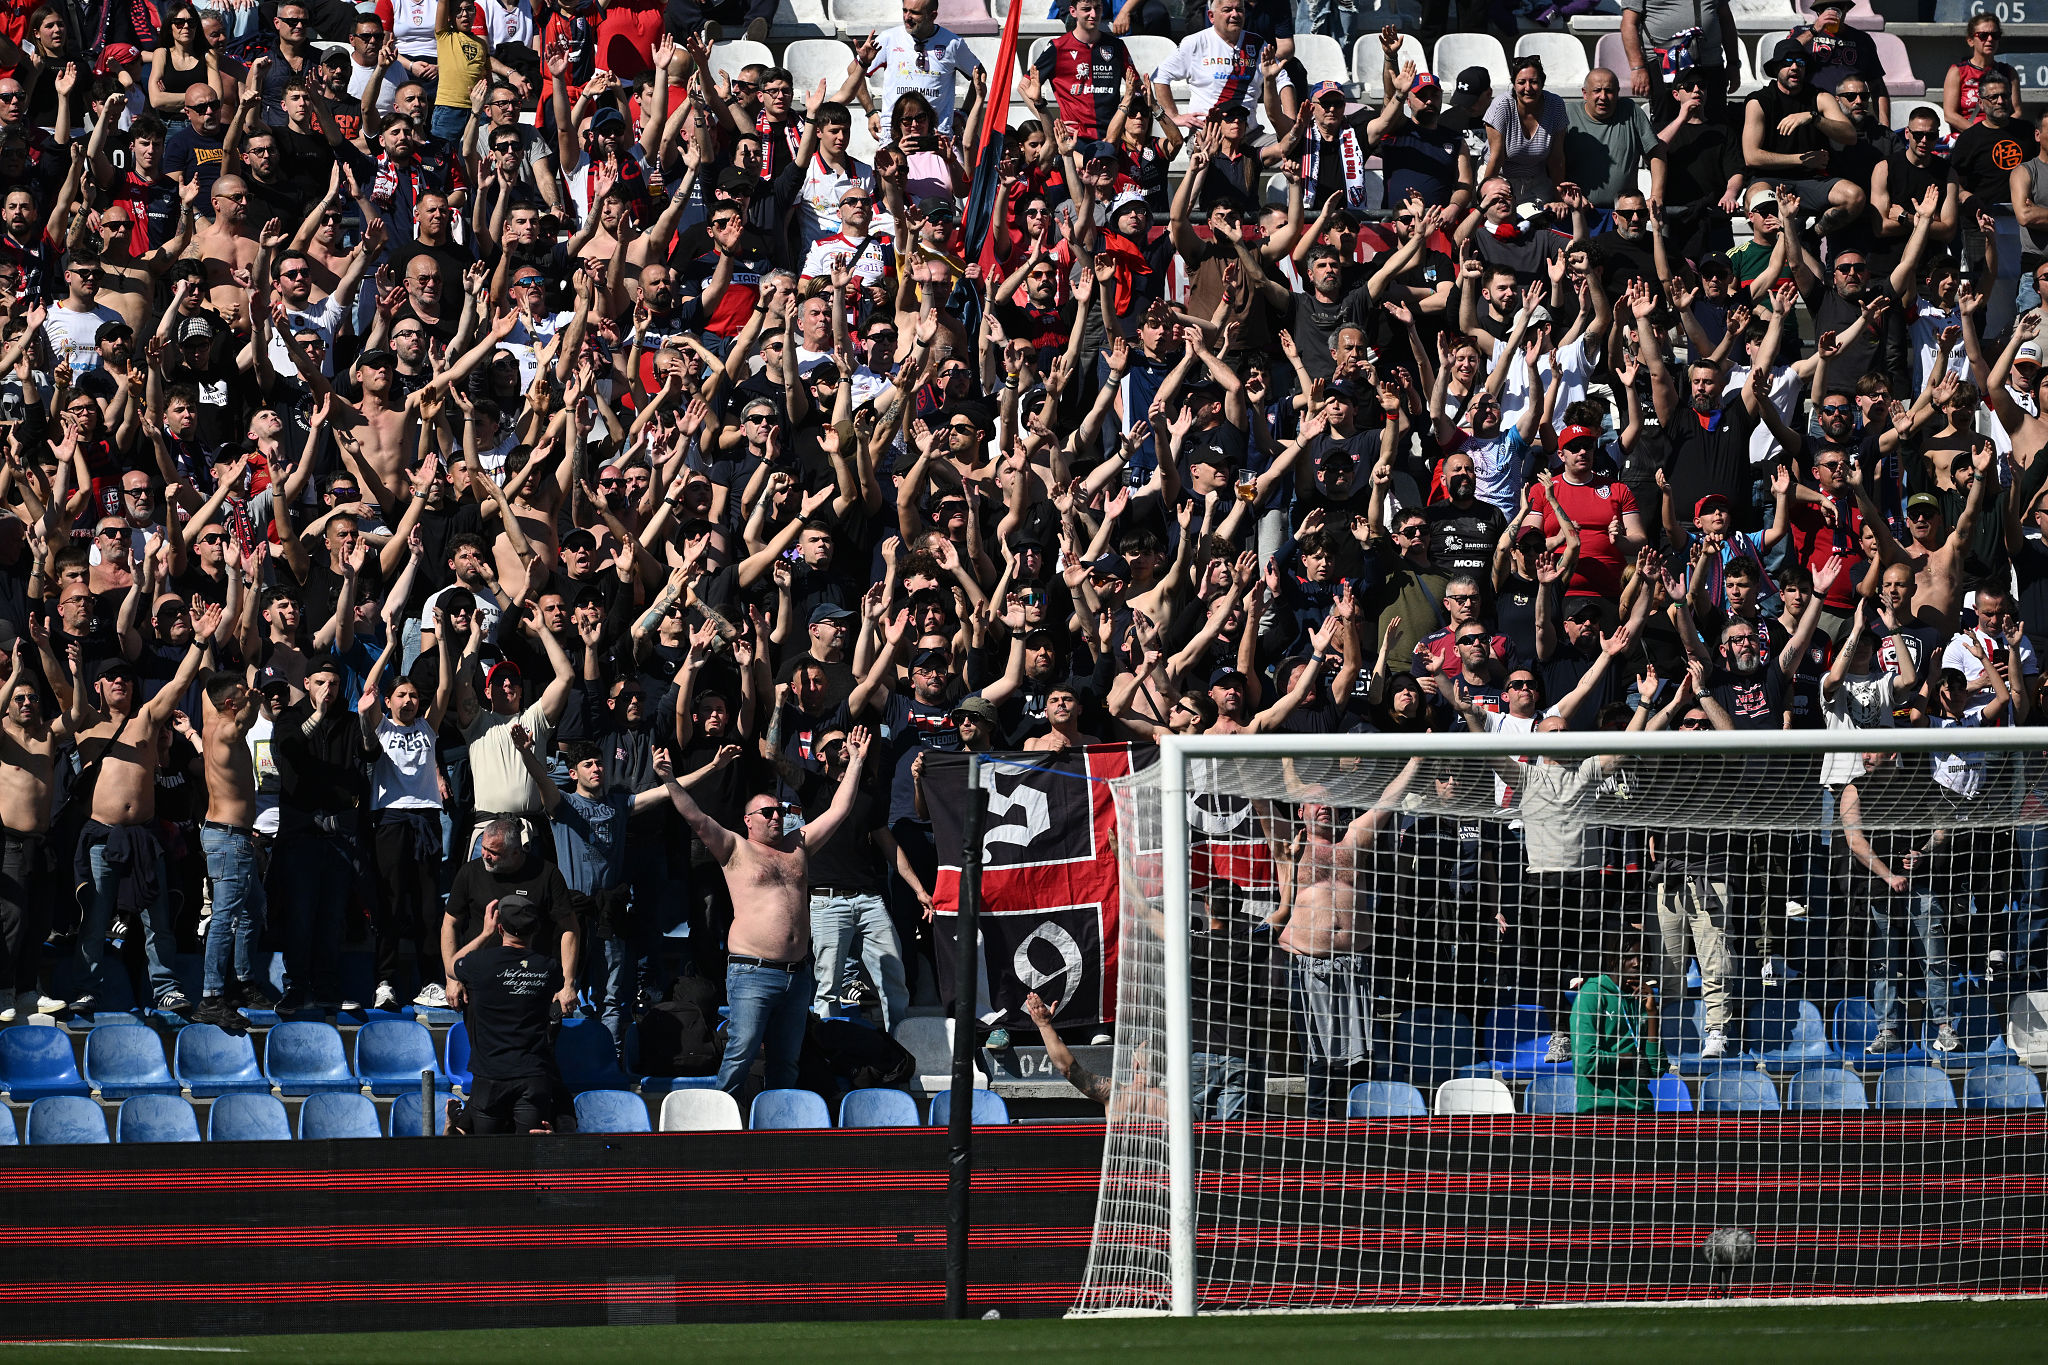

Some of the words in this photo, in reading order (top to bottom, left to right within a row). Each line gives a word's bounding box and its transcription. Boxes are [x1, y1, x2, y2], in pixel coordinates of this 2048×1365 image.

[1995, 2, 2026, 23] 05
[1202, 57, 1257, 67] SARDEGNA
[920, 87, 940, 97] MALTO
[1996, 142, 2018, 166] 悟
[1346, 160, 1357, 180] Una
[707, 274, 761, 285] CLIARI
[1453, 559, 1486, 568] MOBY
[497, 968, 520, 980] Nel
[502, 979, 519, 987] dei
[1019, 1052, 1054, 1076] 04
